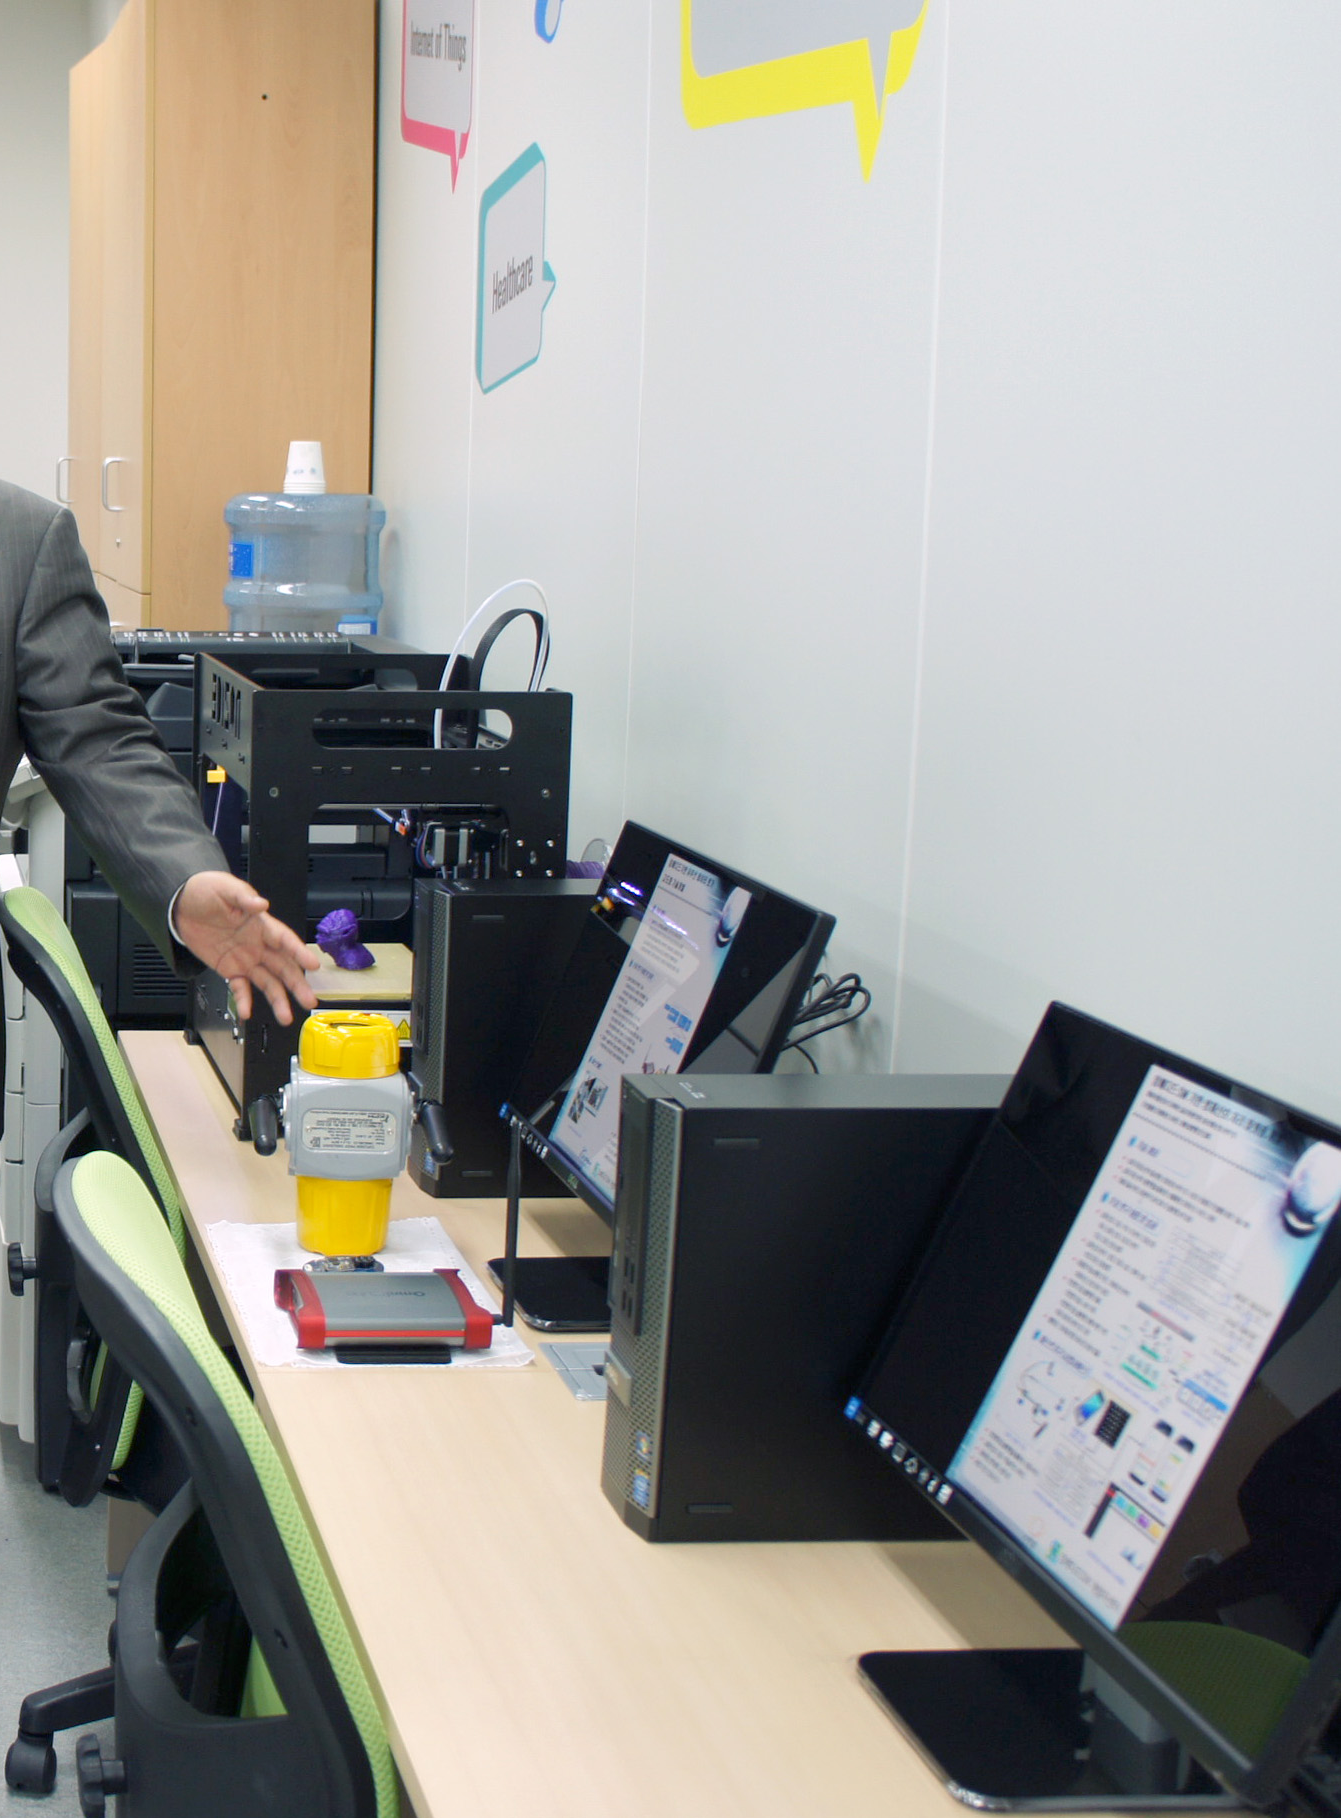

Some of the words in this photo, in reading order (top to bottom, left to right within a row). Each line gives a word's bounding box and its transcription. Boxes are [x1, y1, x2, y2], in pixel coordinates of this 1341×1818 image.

[410, 20, 434, 59] Internet
[434, 23, 442, 60] of
[444, 23, 466, 72] Things
[491, 254, 534, 314] Healthcare
